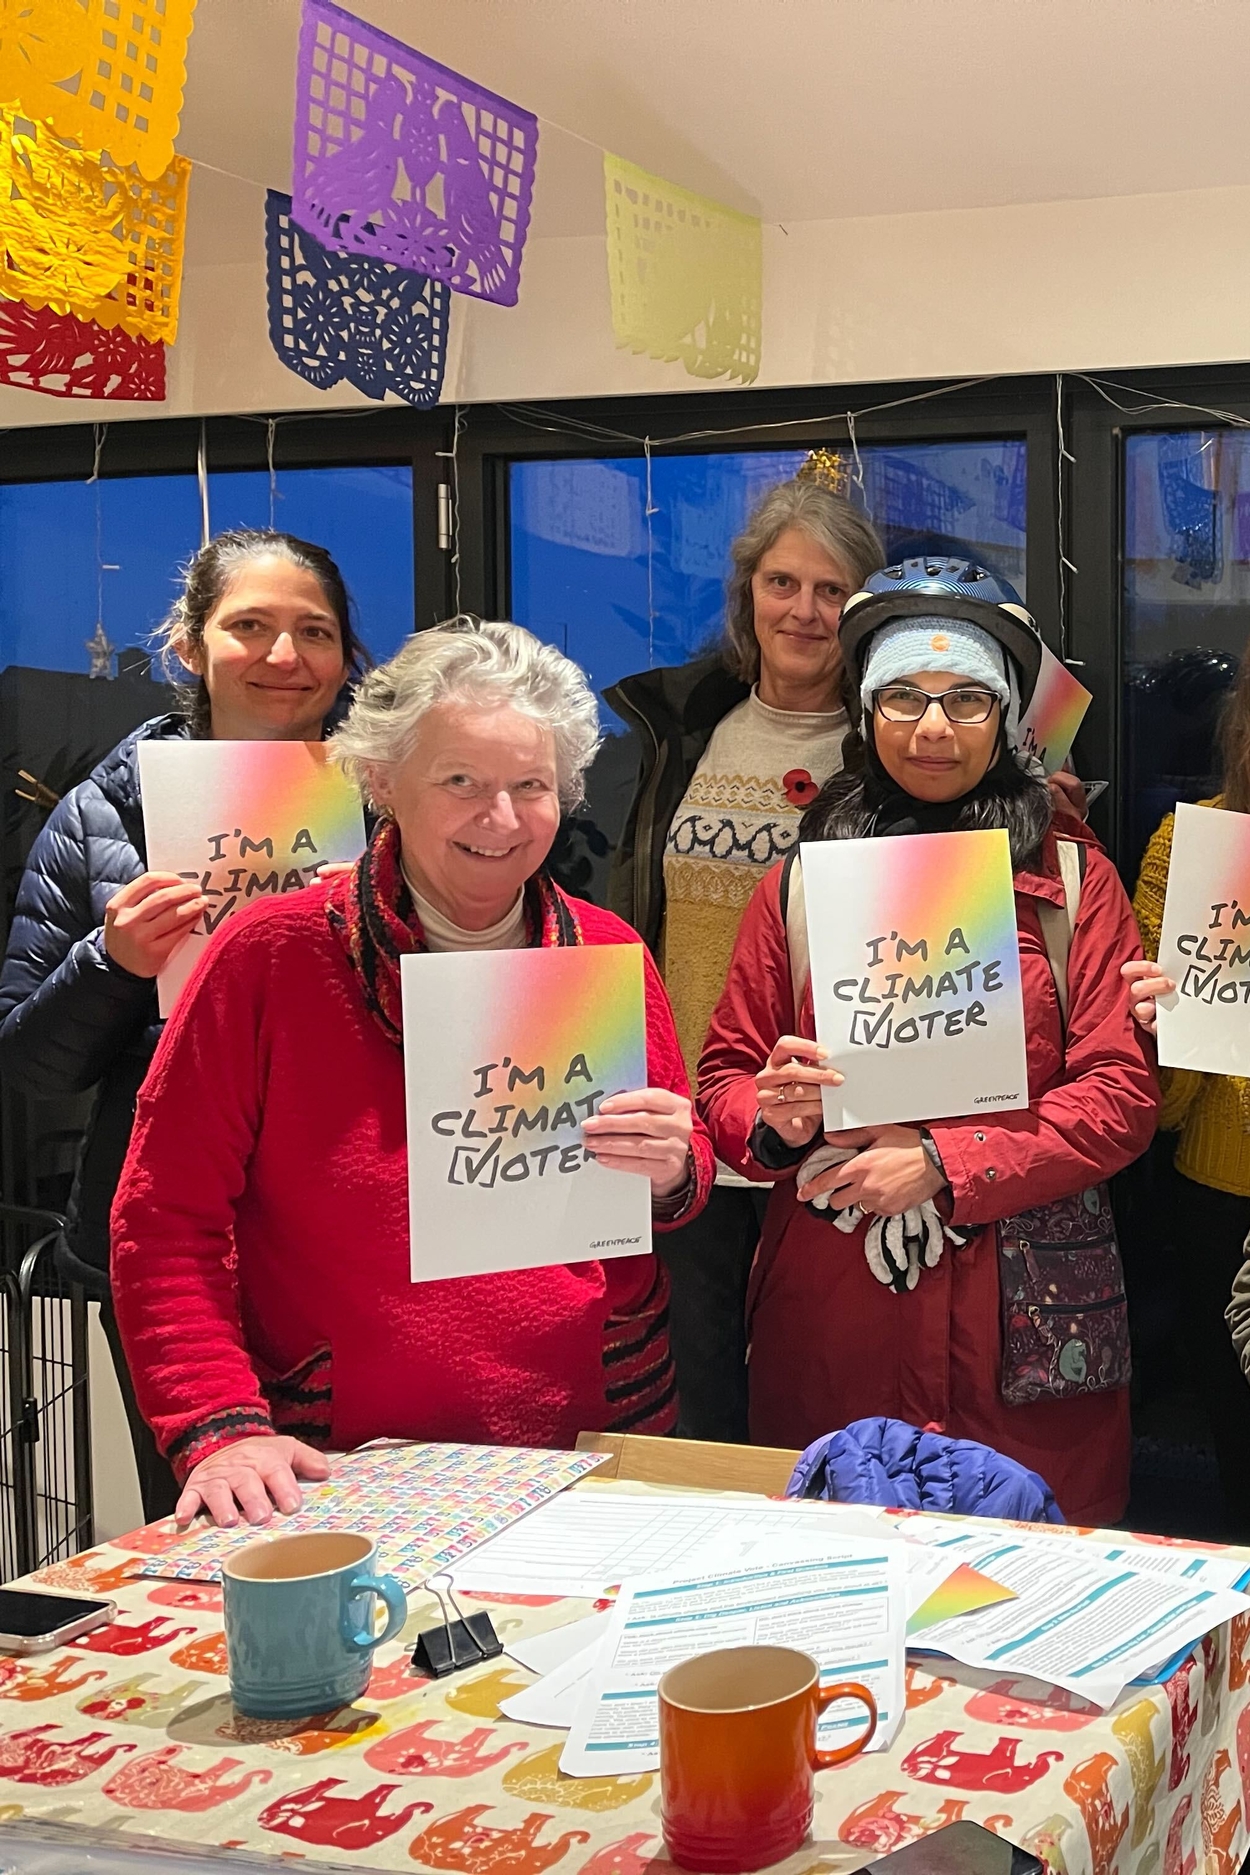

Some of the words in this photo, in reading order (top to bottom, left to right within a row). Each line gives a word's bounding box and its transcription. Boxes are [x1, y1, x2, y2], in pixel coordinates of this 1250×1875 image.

[207, 828, 273, 862] I'M
[291, 828, 318, 854] A
[866, 930, 928, 968] I'M
[944, 927, 970, 955] A
[833, 960, 1004, 1004] CLIMATE
[473, 1056, 545, 1098] I'M
[564, 1053, 593, 1084] A
[431, 1089, 626, 1139] CLIMAT
[973, 1093, 1020, 1105] GREENPEACE
[589, 1235, 642, 1249] GREENPEACE
[673, 1575, 705, 1585] Project
[708, 1569, 741, 1579] Climate
[744, 1564, 764, 1573] Vote
[772, 1557, 824, 1568] Canvassing
